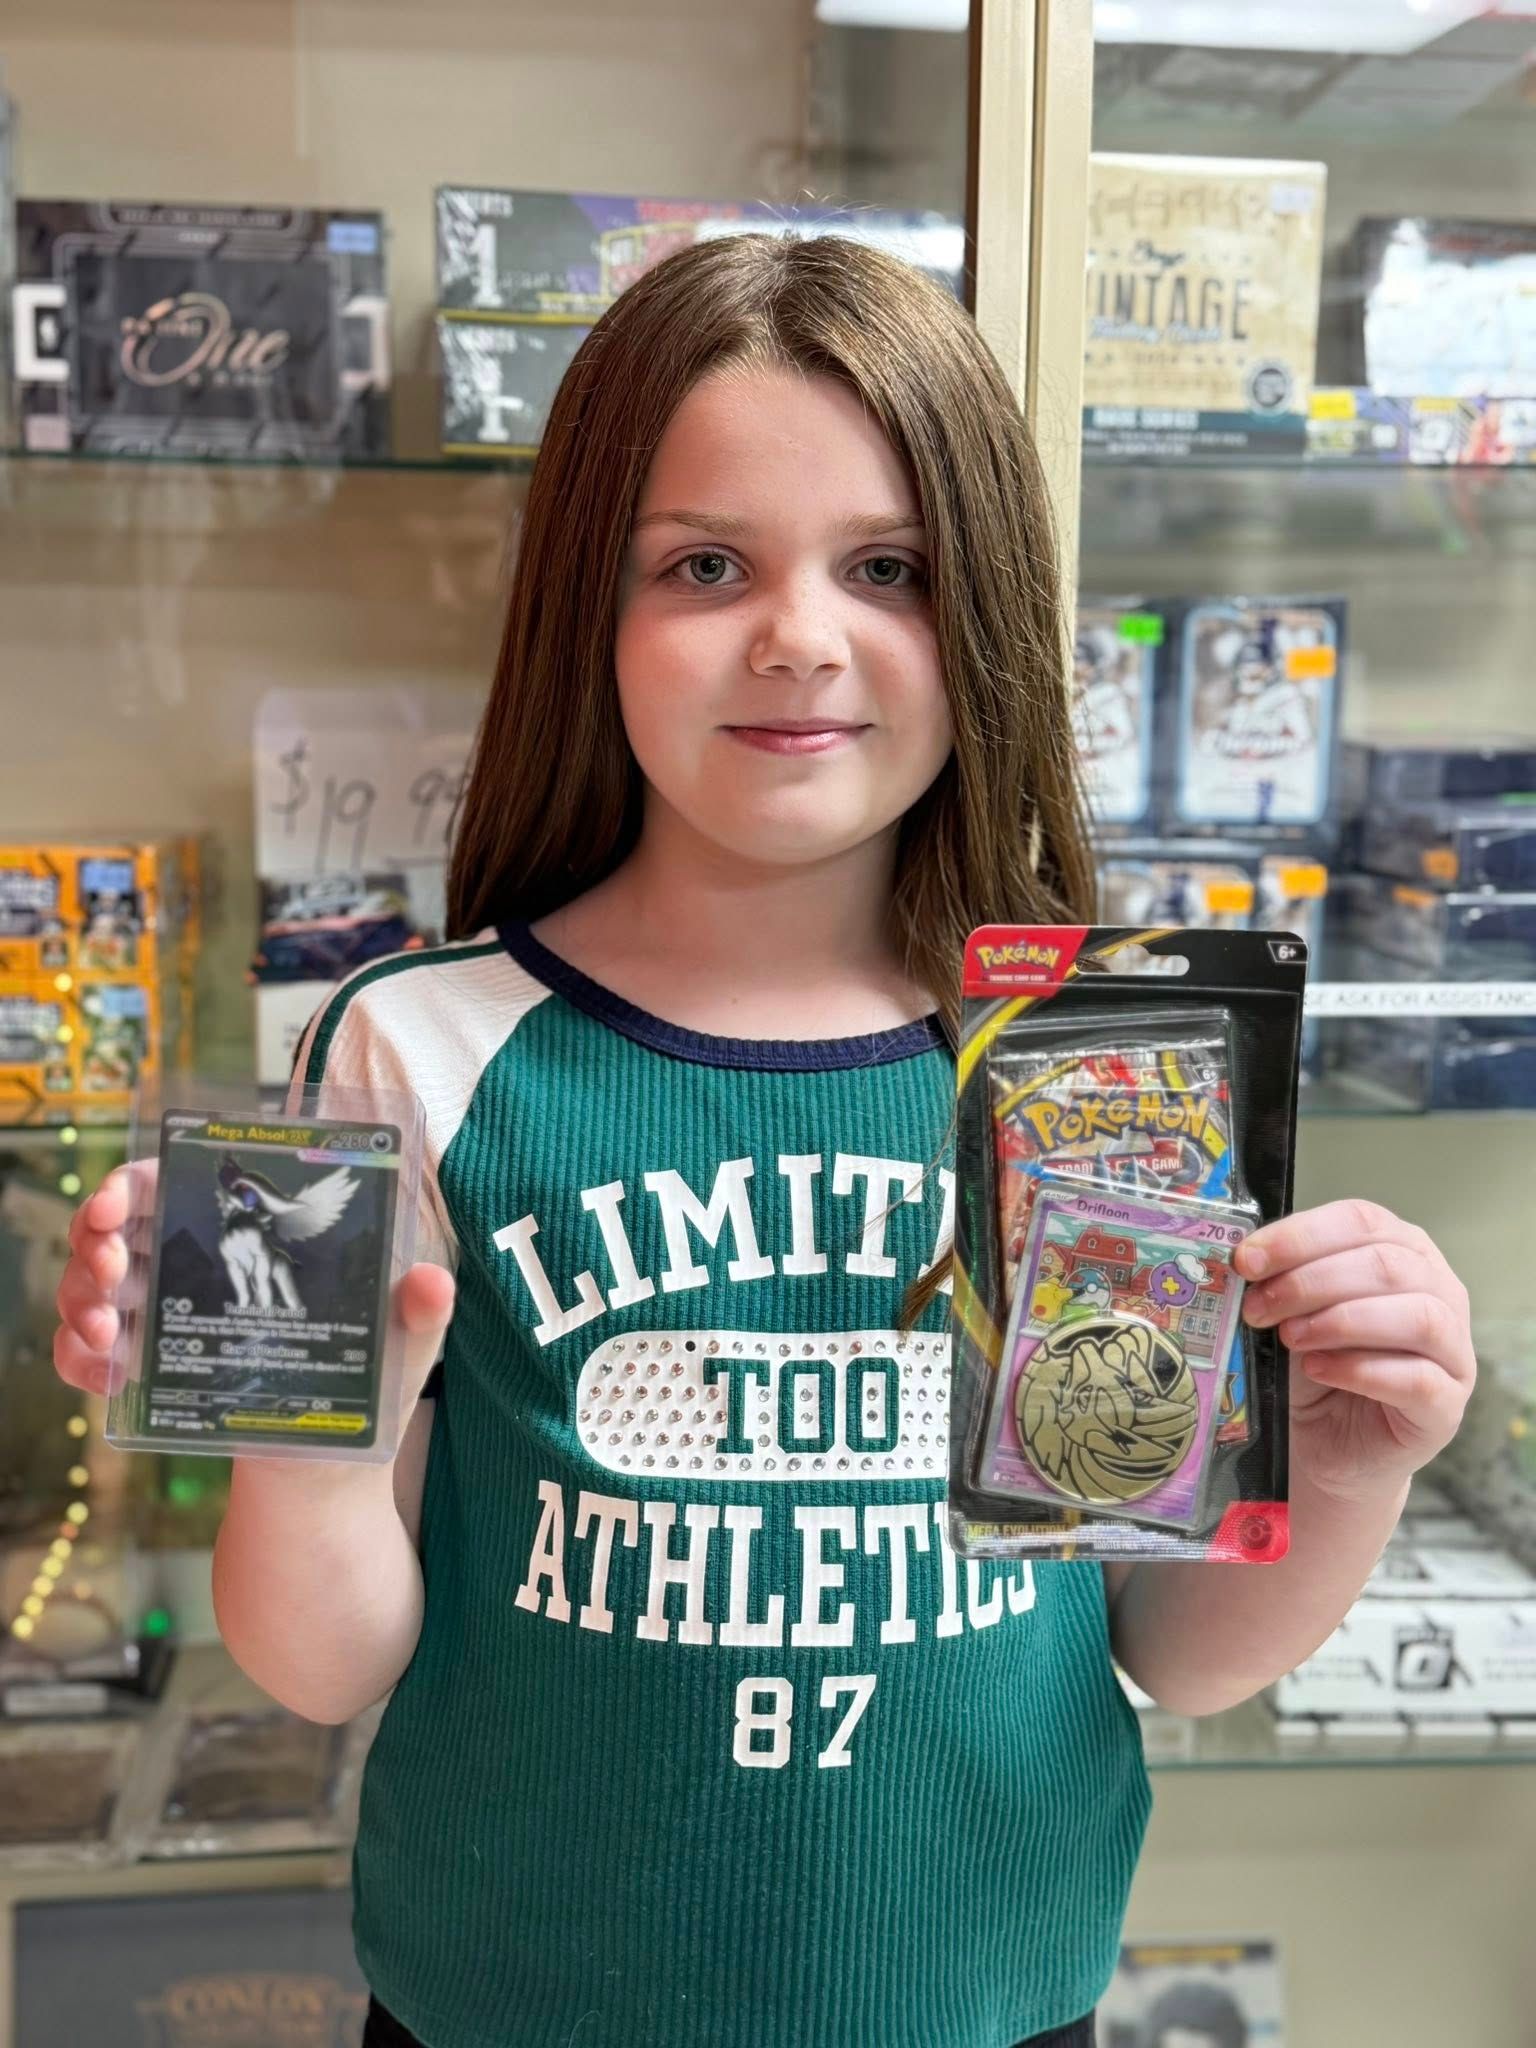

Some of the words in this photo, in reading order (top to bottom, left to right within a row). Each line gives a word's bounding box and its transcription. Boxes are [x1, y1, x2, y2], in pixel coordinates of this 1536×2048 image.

[1086, 272, 1250, 340] INTAGE
[1278, 945, 1296, 959] 6+
[1337, 991, 1373, 1007] ASK
[1379, 991, 1416, 1007] FOR
[207, 1124, 243, 1142] Mega
[247, 1126, 285, 1141] Absol
[1151, 1157, 1183, 1170] GAM
[1077, 1199, 1130, 1221] Drifloon
[1207, 1223, 1226, 1241] 70
[492, 1153, 955, 1347] LIMIT
[703, 1357, 900, 1455] TOO
[732, 1674, 877, 1769] 87
